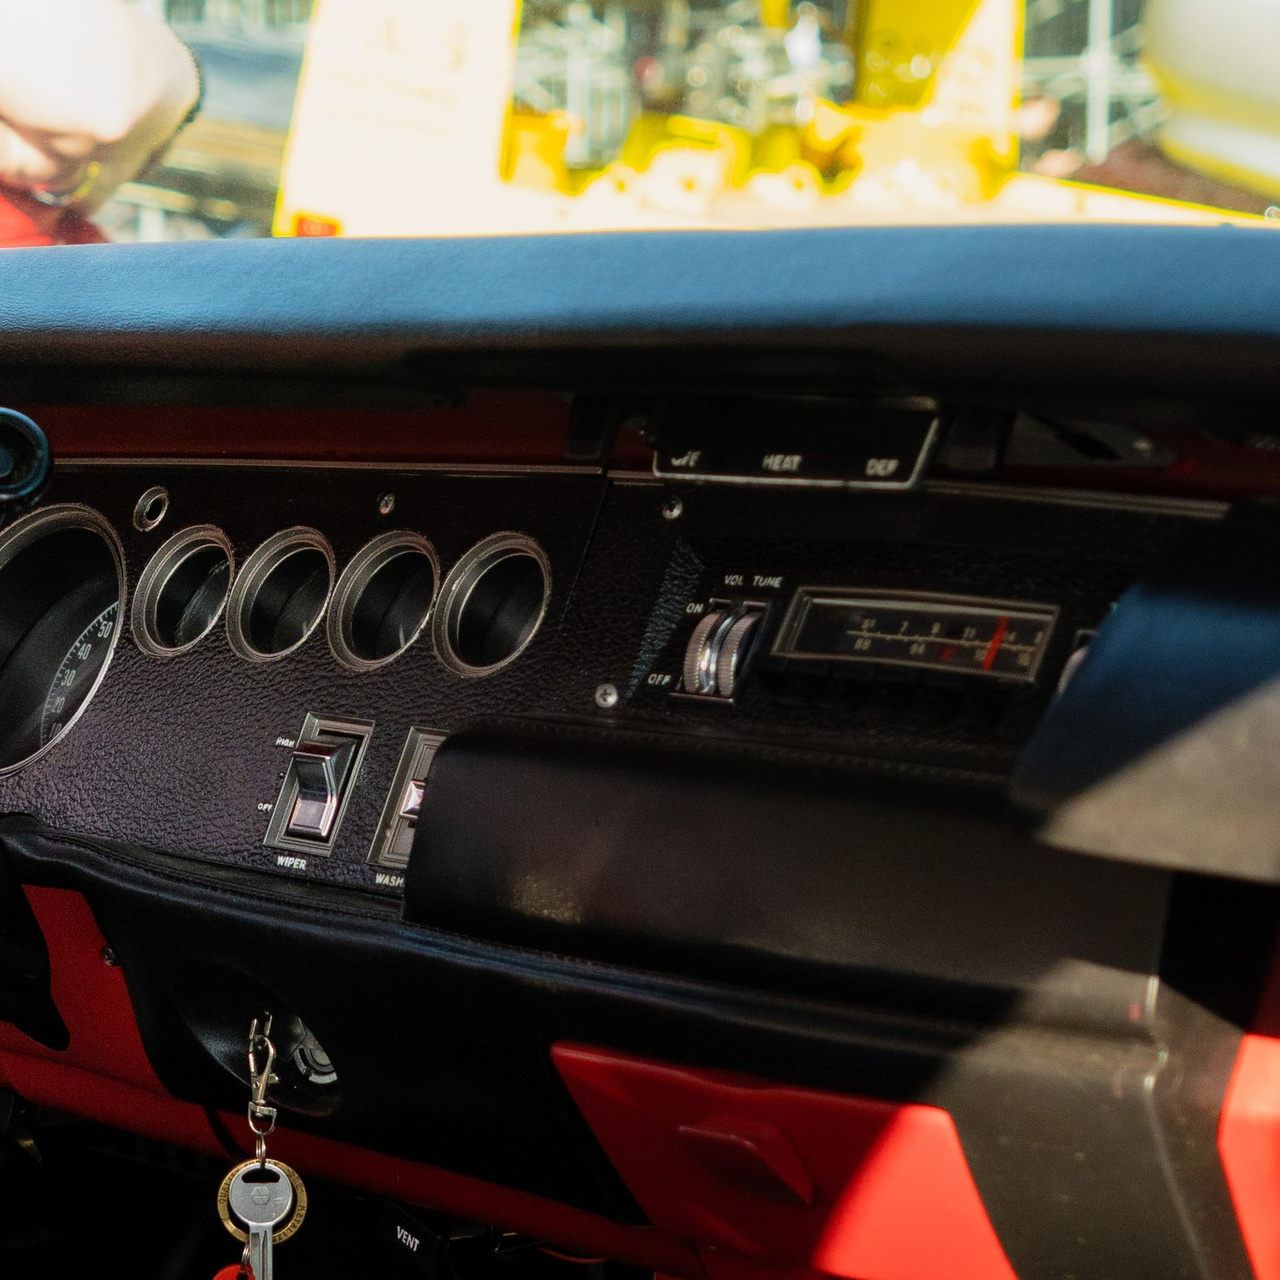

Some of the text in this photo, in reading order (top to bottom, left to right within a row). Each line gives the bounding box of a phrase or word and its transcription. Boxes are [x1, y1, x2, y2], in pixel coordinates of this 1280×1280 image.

[762, 453, 802, 472] HEAT
[724, 574, 783, 589] VOL TUNE
[685, 602, 704, 614] ON
[98, 621, 113, 638] 50
[77, 643, 92, 660] 40
[61, 669, 76, 686] 30
[647, 673, 671, 686] OFF
[51, 696, 66, 714] 20
[257, 802, 273, 813] OFF
[276, 855, 308, 871] WIPER
[375, 872, 405, 887] WASH
[396, 1224, 420, 1252] VENT
